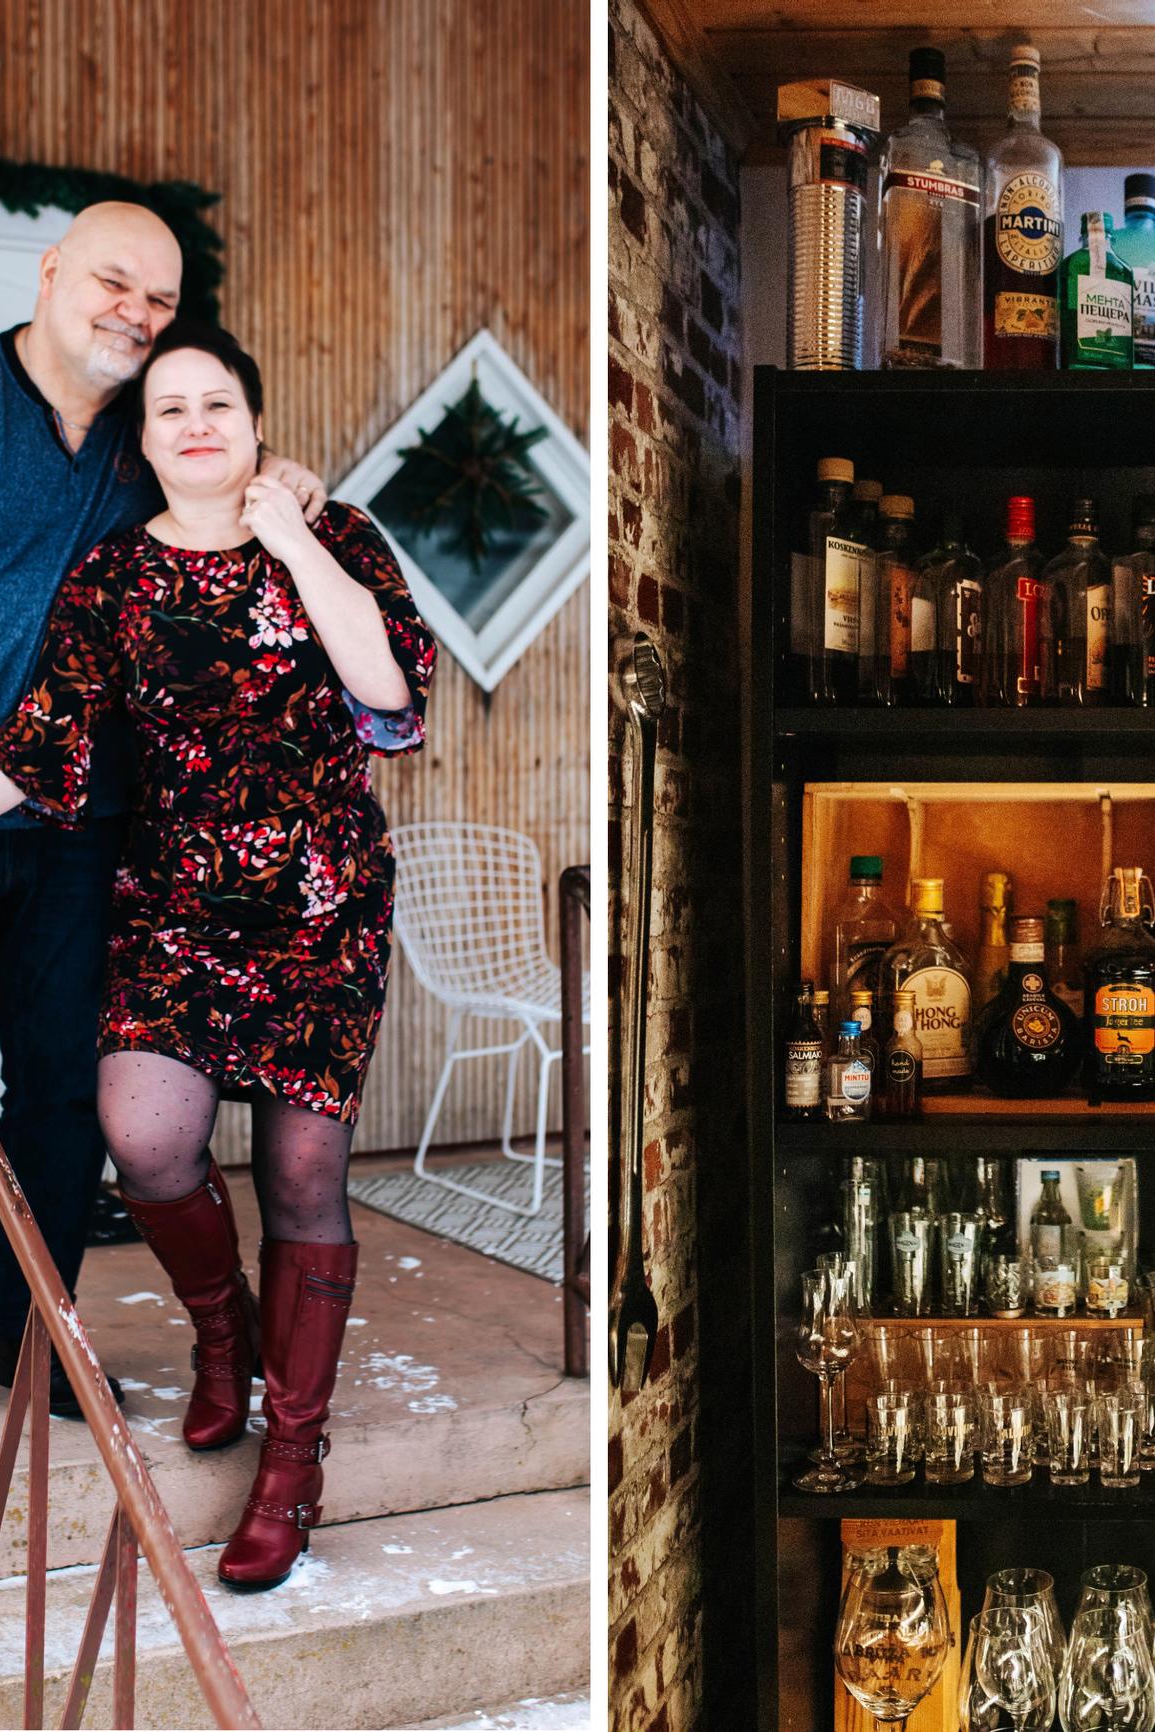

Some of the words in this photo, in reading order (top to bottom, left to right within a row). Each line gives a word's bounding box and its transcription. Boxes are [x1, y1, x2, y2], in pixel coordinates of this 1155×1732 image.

[907, 176, 964, 198] STUMBRAS
[1002, 215, 1059, 236] MARTINI
[1086, 293, 1125, 309] МЕНТА
[1080, 304, 1130, 324] ПЕЩЕРА
[915, 1006, 957, 1020] HONG
[1017, 1005, 1055, 1021] UNICUM
[1102, 997, 1147, 1012] STROH
[1017, 1027, 1058, 1046] BARISTA
